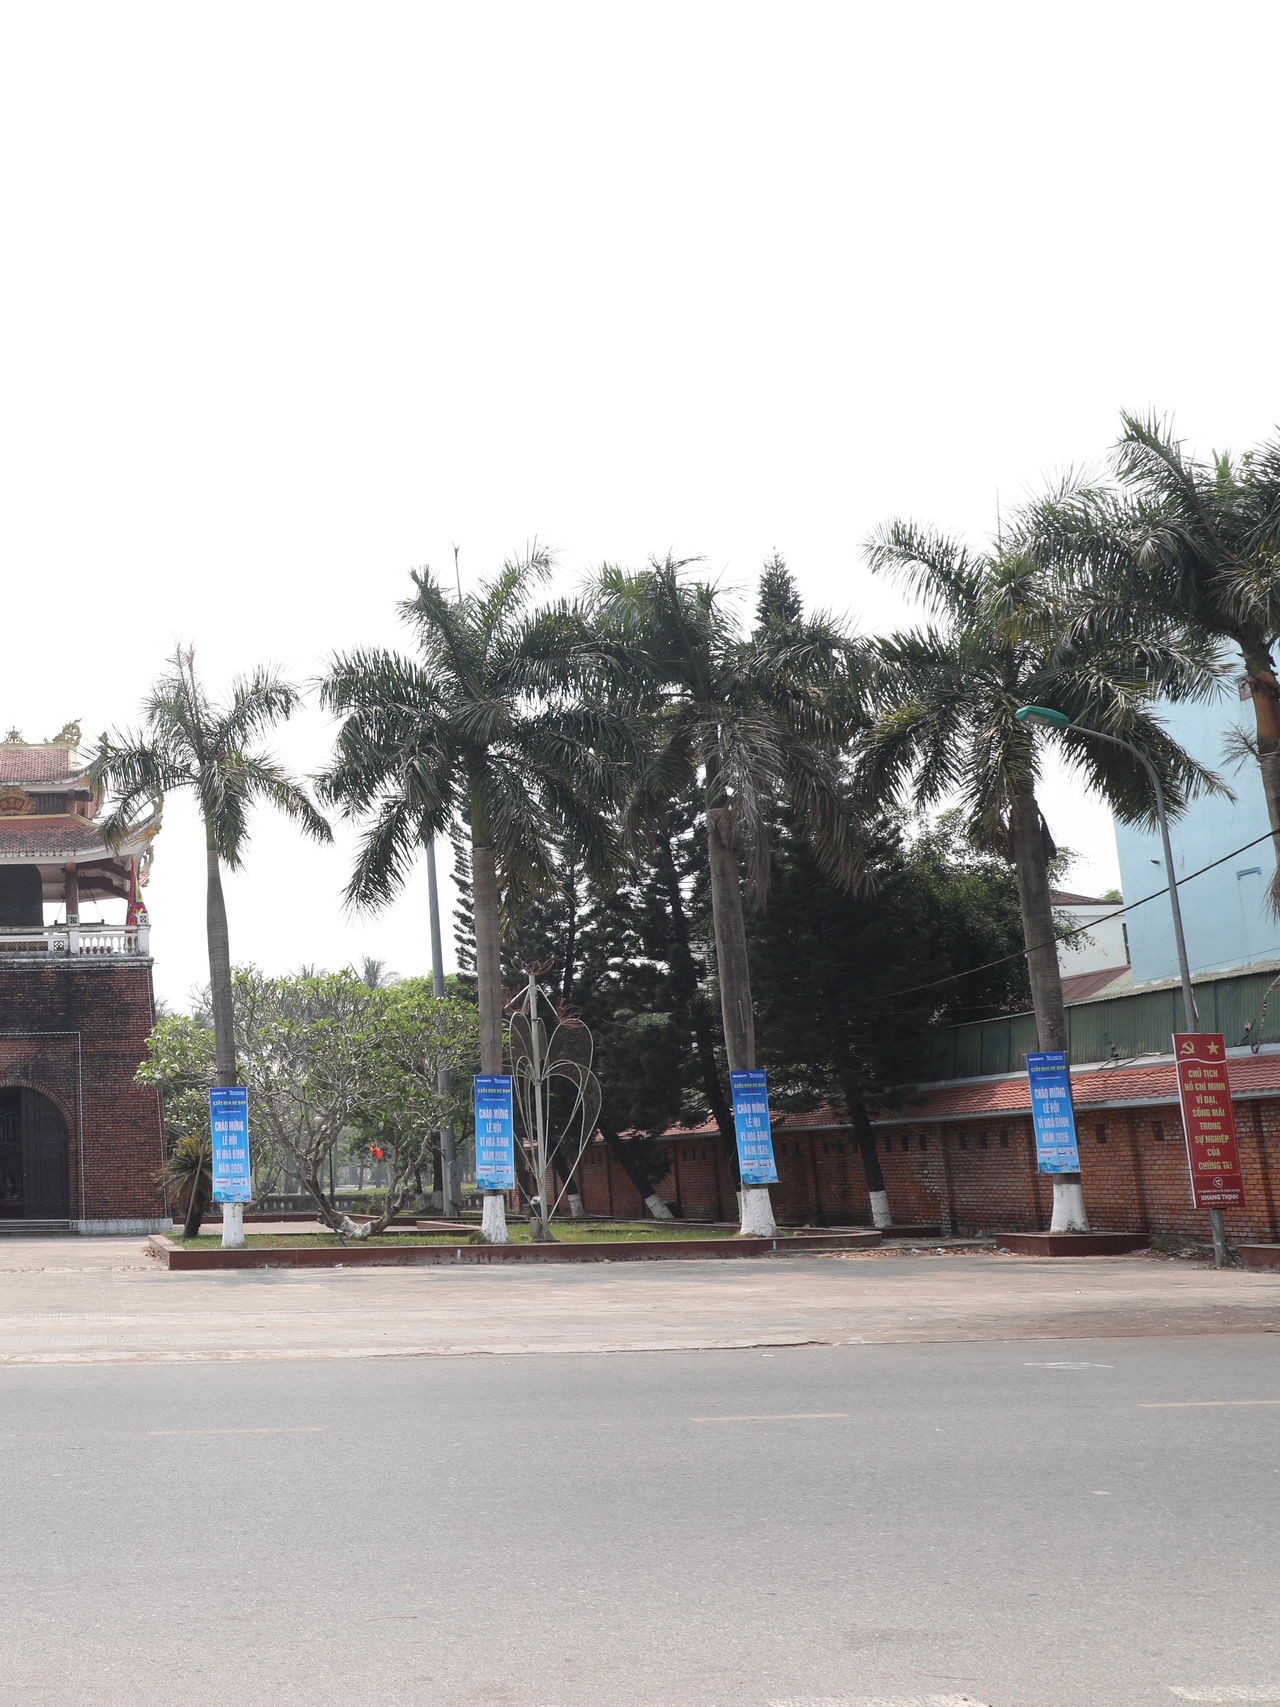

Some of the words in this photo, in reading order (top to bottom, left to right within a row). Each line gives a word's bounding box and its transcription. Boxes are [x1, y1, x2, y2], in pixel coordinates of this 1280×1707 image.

[1188, 1068, 1202, 1078] CHỦ
[1203, 1070, 1218, 1079] TỊCH
[1184, 1081, 1194, 1091] HỒ
[1195, 1082, 1207, 1090] CHÍ
[1204, 1096, 1217, 1105] ĐẠI,
[1192, 1106, 1211, 1117] SỐNG
[1212, 1107, 1225, 1117] MÃI
[1199, 1122, 1221, 1130] TRONG
[1195, 1135, 1204, 1145] SỰ
[1205, 1134, 1230, 1144] NGHIỆP
[1207, 1146, 1221, 1157] CỦA
[1198, 1159, 1221, 1170] CHÚNG
